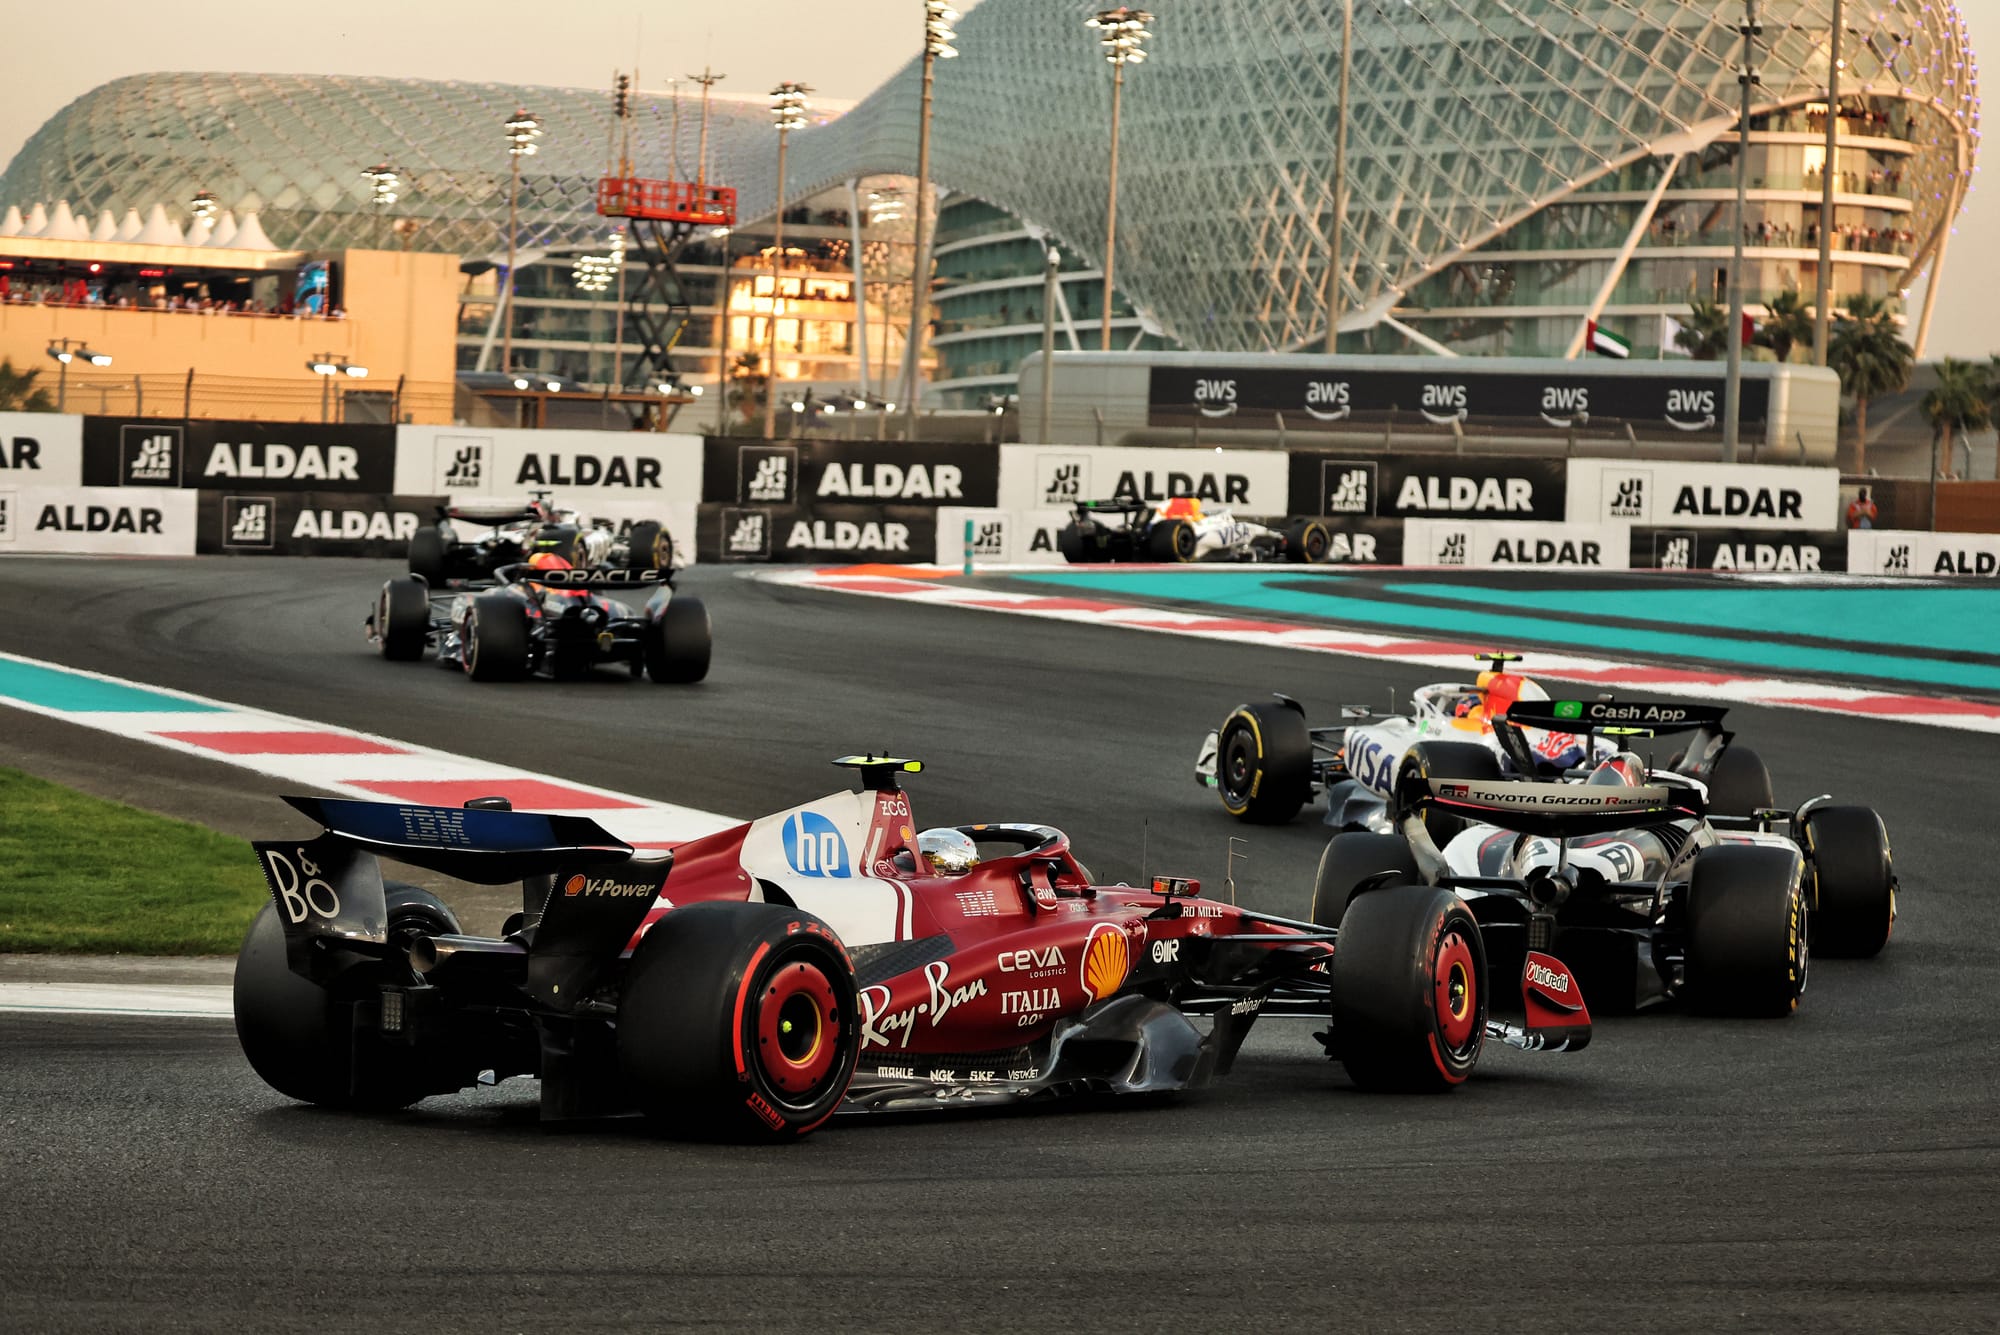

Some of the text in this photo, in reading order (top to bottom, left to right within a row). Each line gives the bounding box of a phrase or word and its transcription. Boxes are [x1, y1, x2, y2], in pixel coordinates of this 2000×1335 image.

[1194, 379, 1237, 401] aws
[1306, 381, 1350, 403] aws
[1421, 384, 1467, 407] aws
[1541, 386, 1588, 409] aws
[1666, 388, 1715, 413] aws
[204, 443, 360, 481] ALDAR
[516, 453, 663, 488] ALDAR
[817, 462, 964, 499] ALDAR
[1112, 470, 1251, 504] ALDAR
[1396, 475, 1534, 512] ALDAR
[1673, 485, 1803, 519] ALDAR
[35, 504, 164, 534] ALDAR
[292, 509, 419, 540] ALDAR
[786, 520, 910, 551] ALDAR
[1218, 523, 1251, 546] VISA
[1492, 539, 1602, 566] ALDAR
[1712, 543, 1822, 572] ALDAR
[545, 569, 660, 583] ORACLE
[1590, 703, 1641, 719] Cash
[1644, 705, 1687, 722] App
[1348, 730, 1395, 799] VISA
[879, 800, 908, 816] ZCG
[1473, 791, 1537, 803] TOYOTA
[1605, 795, 1662, 807] Racing
[399, 808, 471, 844] IBM
[794, 811, 841, 878] hp
[585, 878, 656, 897] V-Power
[954, 890, 999, 917] IBM
[1197, 906, 1223, 918] MILLE
[1029, 967, 1067, 979] LOGISTICS
[1534, 964, 1568, 993] UniCredit
[1000, 987, 1062, 1014] ITALIA
[877, 1066, 914, 1079] MAHLE
[929, 1069, 956, 1083] NGK
[969, 1070, 996, 1081] SKF
